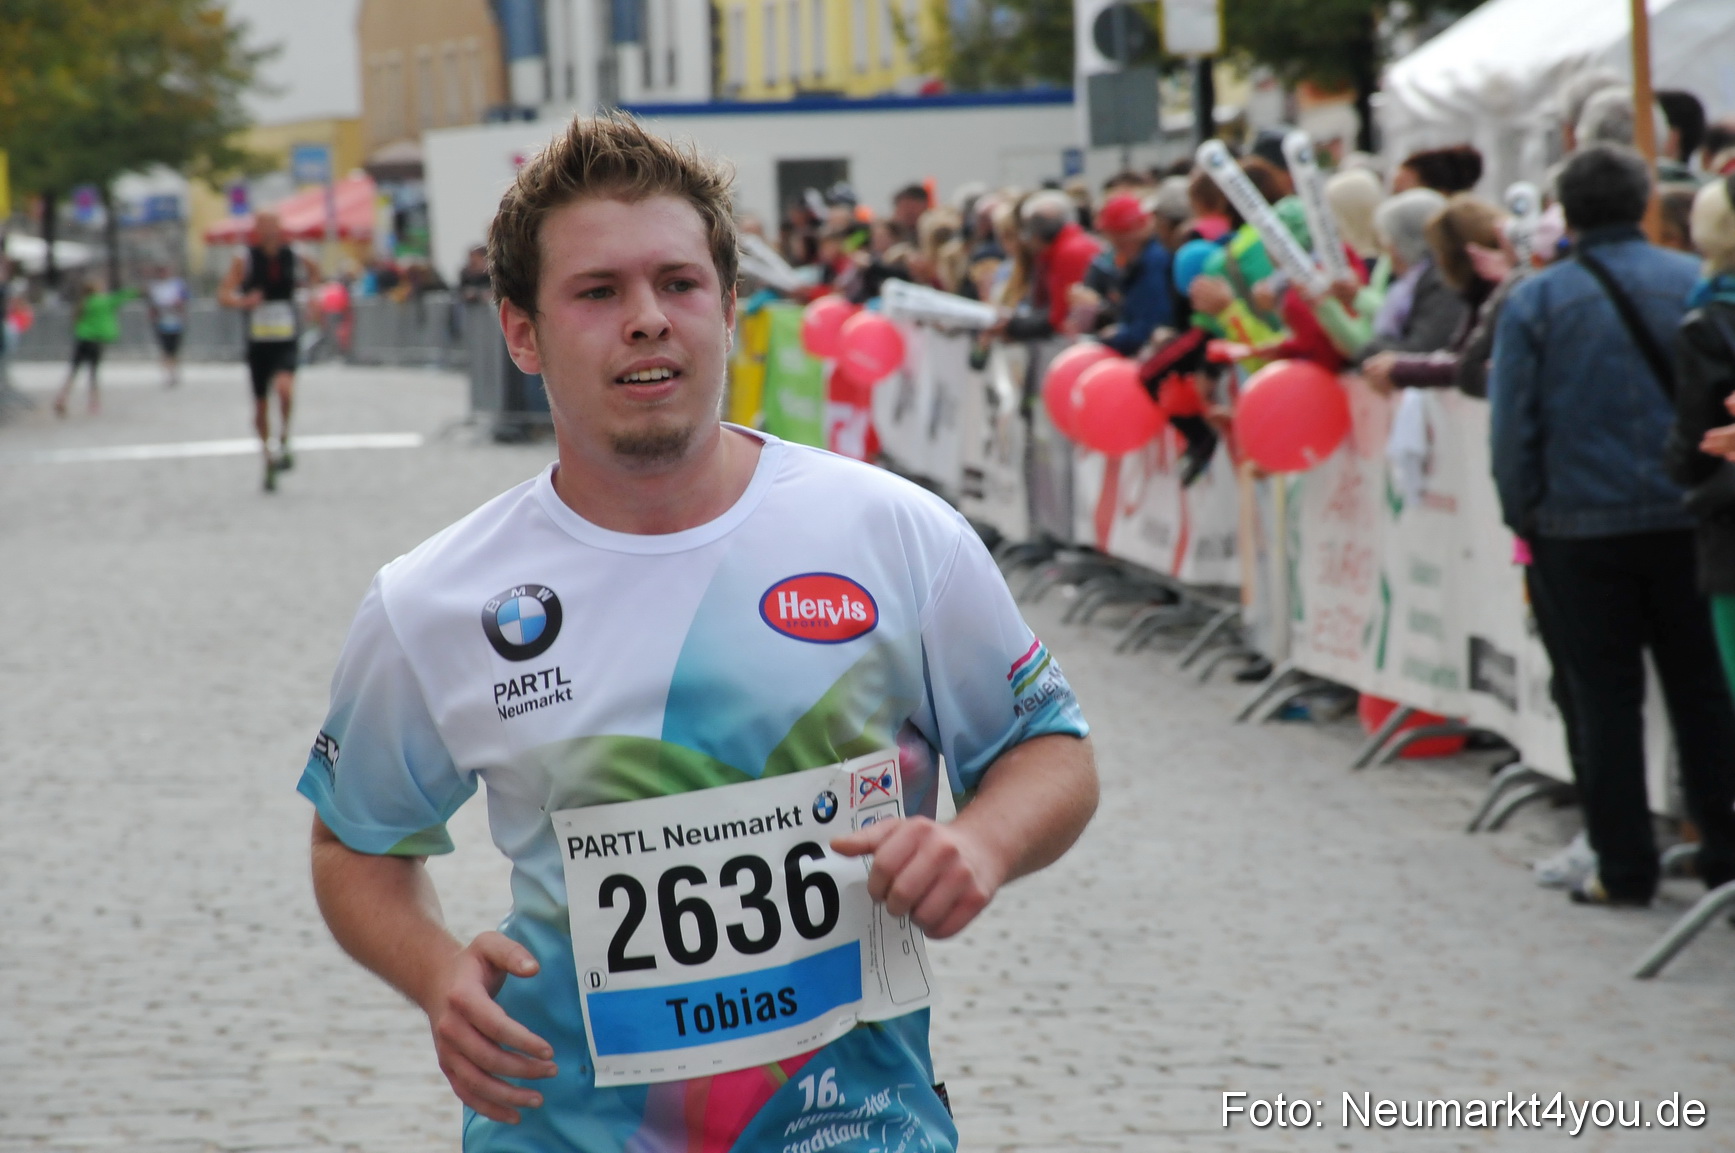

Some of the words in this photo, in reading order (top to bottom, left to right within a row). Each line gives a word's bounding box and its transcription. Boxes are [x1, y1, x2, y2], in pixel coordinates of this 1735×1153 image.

[486, 586, 553, 614] BMW
[777, 591, 867, 625] Hervis
[494, 666, 572, 705] PARTL
[498, 687, 573, 721] Neumarkt
[567, 830, 657, 860] PARTL
[662, 805, 803, 850] Neumarkt
[598, 841, 840, 974] 2636
[590, 971, 601, 988] D
[665, 986, 798, 1036] Tobias
[798, 1067, 846, 1113] 16.
[784, 1087, 892, 1138] Neumarkter
